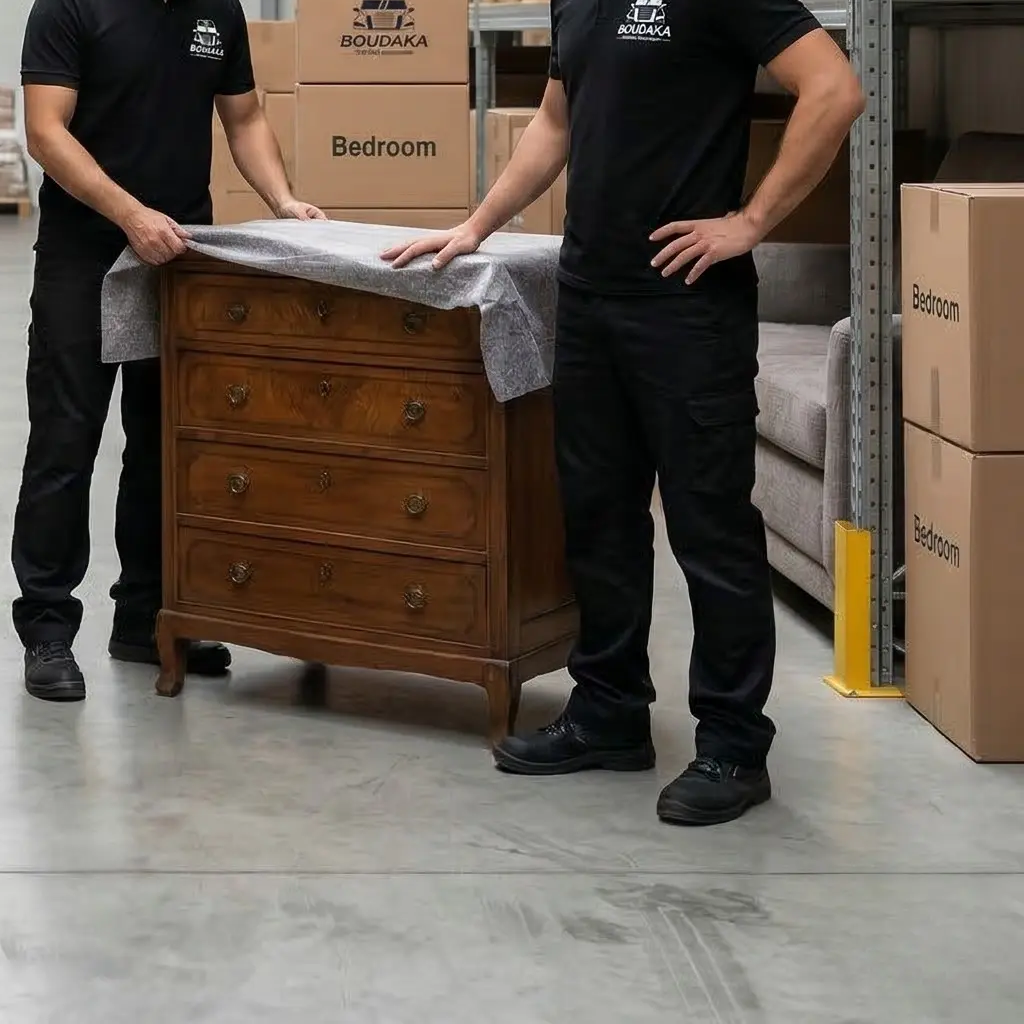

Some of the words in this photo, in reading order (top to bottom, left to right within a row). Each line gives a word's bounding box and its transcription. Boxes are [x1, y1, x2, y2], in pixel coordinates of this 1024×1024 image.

[617, 24, 671, 37] BOUDAKA
[340, 35, 428, 47] BOUDAKA
[332, 136, 436, 156] Bedroom
[913, 284, 960, 322] Bedroom
[914, 514, 960, 568] Bedroom
